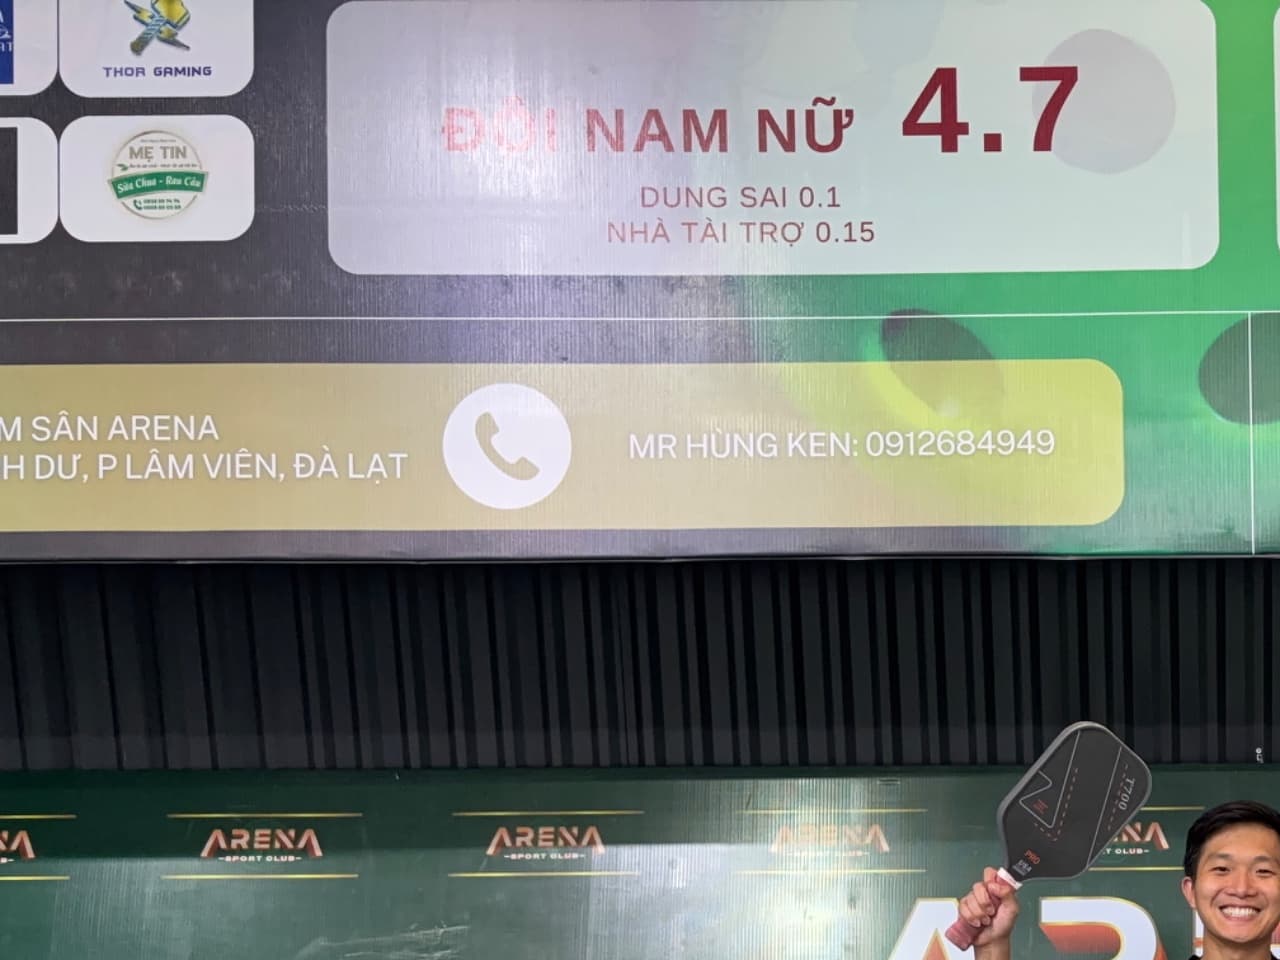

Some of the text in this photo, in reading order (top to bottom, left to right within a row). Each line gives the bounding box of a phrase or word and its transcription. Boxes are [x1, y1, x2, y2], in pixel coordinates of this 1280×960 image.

[103, 65, 212, 78] THOR GAMING
[586, 107, 730, 153] NAM
[756, 96, 855, 153] NỮ
[902, 66, 1079, 153] 4.7
[129, 145, 187, 162] MẸ TIN
[641, 185, 842, 210] DUNG SAI 0.1
[607, 218, 875, 247] NHÀ TÀI TRỢ 0.15
[32, 410, 98, 441] SÂN
[108, 415, 219, 441] ARENA
[630, 427, 1055, 459] MR HÙNG KEN: 0912684949
[35, 454, 88, 483] DƯ,
[99, 454, 118, 480] P
[126, 446, 194, 479] LÂM
[202, 447, 285, 482] VIÊN,
[293, 445, 339, 479] ĐÀ
[348, 453, 409, 485] LẠT
[1117, 777, 1135, 810] T700
[200, 828, 323, 858] ARENA
[486, 826, 605, 856] ARENA
